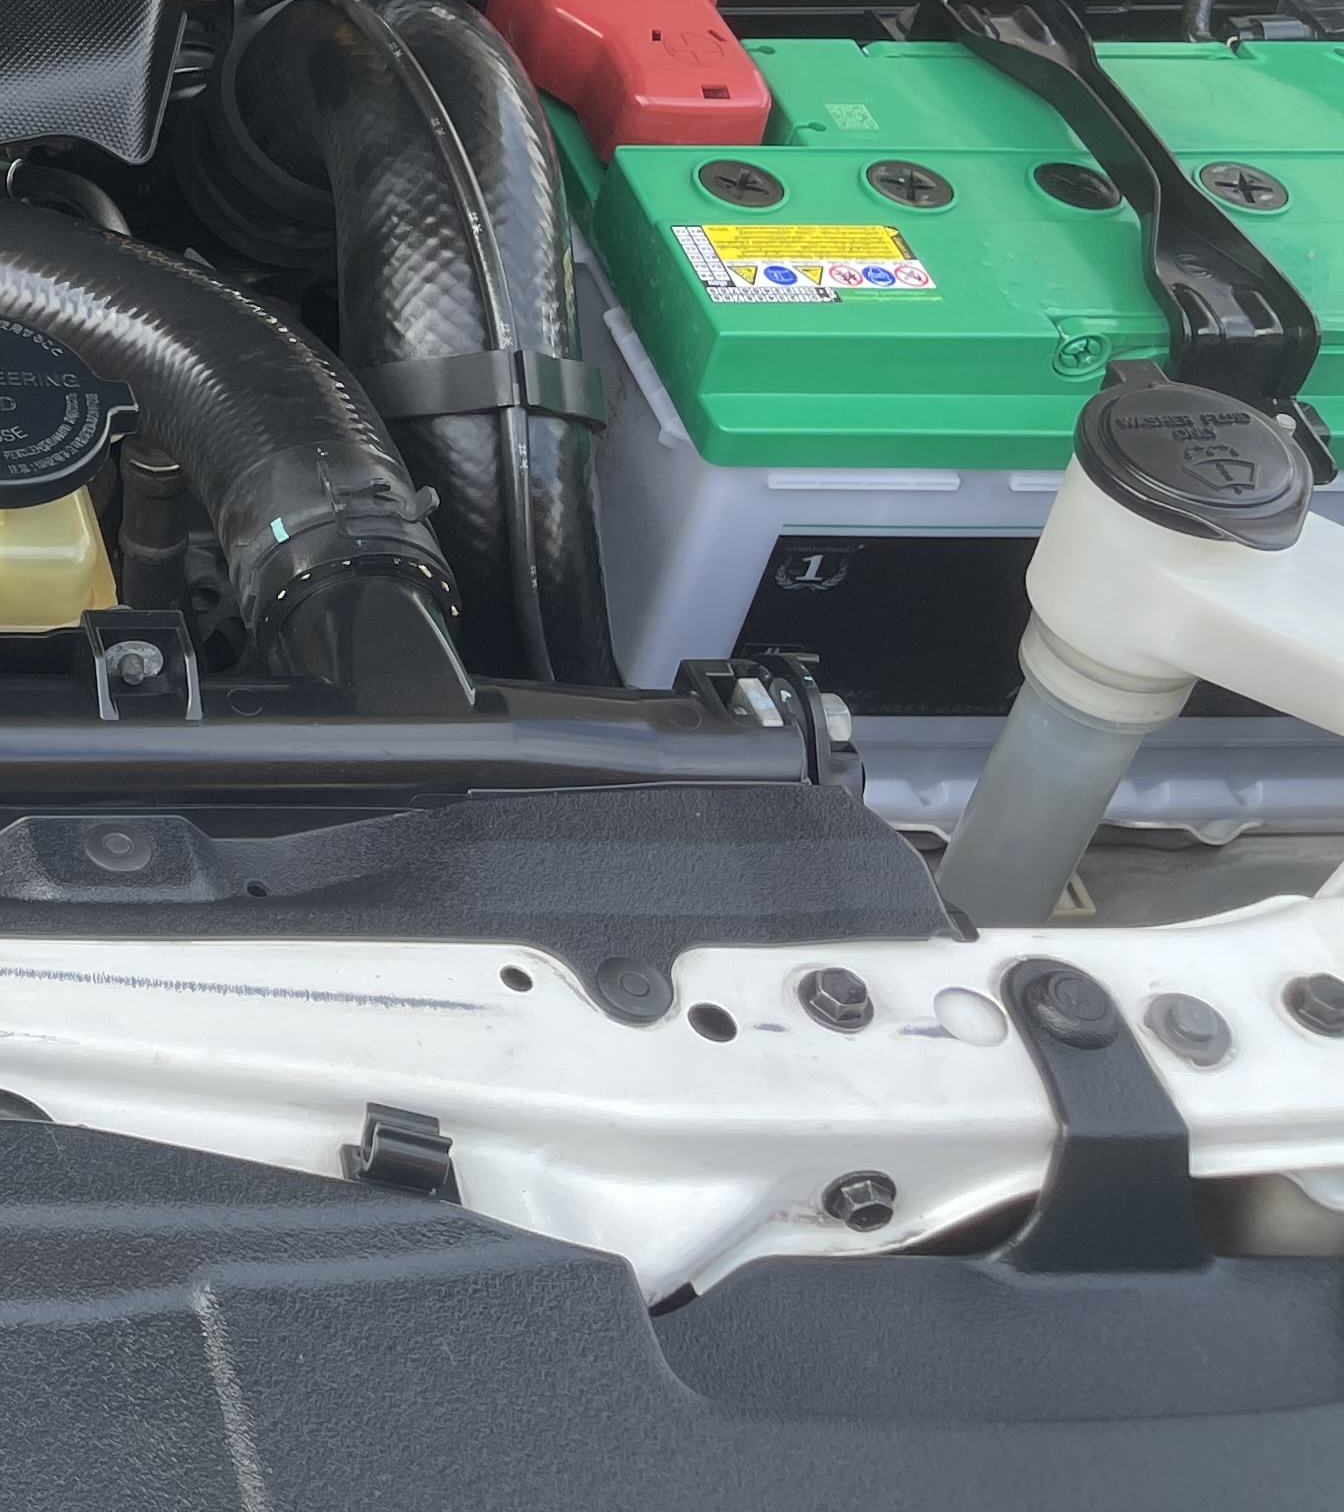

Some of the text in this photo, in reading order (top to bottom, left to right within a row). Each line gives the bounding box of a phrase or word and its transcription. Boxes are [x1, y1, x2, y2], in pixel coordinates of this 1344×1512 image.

[1114, 412, 1251, 430] WASHER FLUID
[1173, 427, 1217, 442] ONLY
